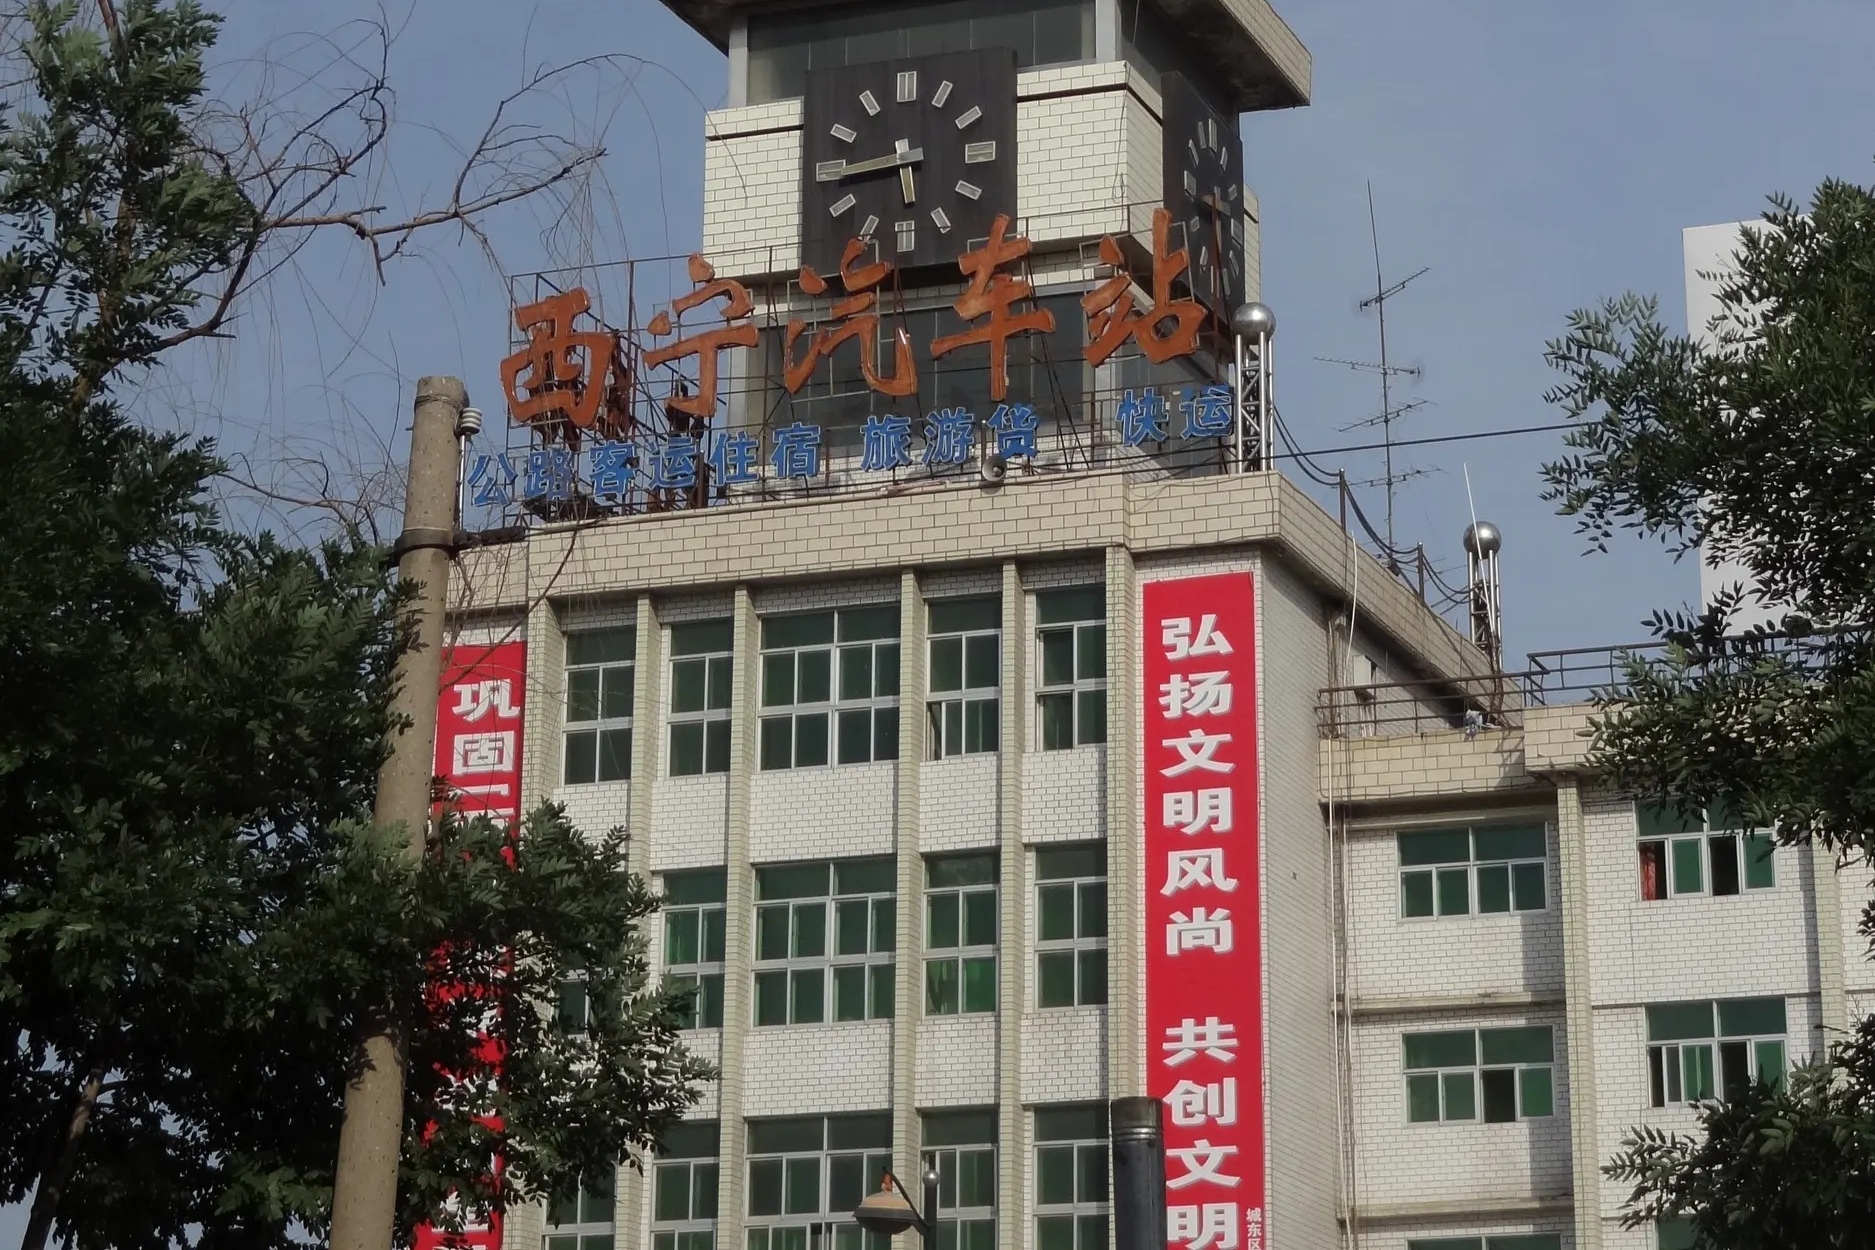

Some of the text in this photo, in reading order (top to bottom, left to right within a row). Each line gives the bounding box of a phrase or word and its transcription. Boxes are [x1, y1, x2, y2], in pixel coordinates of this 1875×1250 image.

[499, 207, 1207, 430] 西宁汽车站
[467, 421, 822, 508] 公路客运住宿
[1115, 382, 1236, 447] 快运
[1158, 613, 1239, 957] 弘扬文明风尚
[1162, 1016, 1241, 1250] 共创文明
